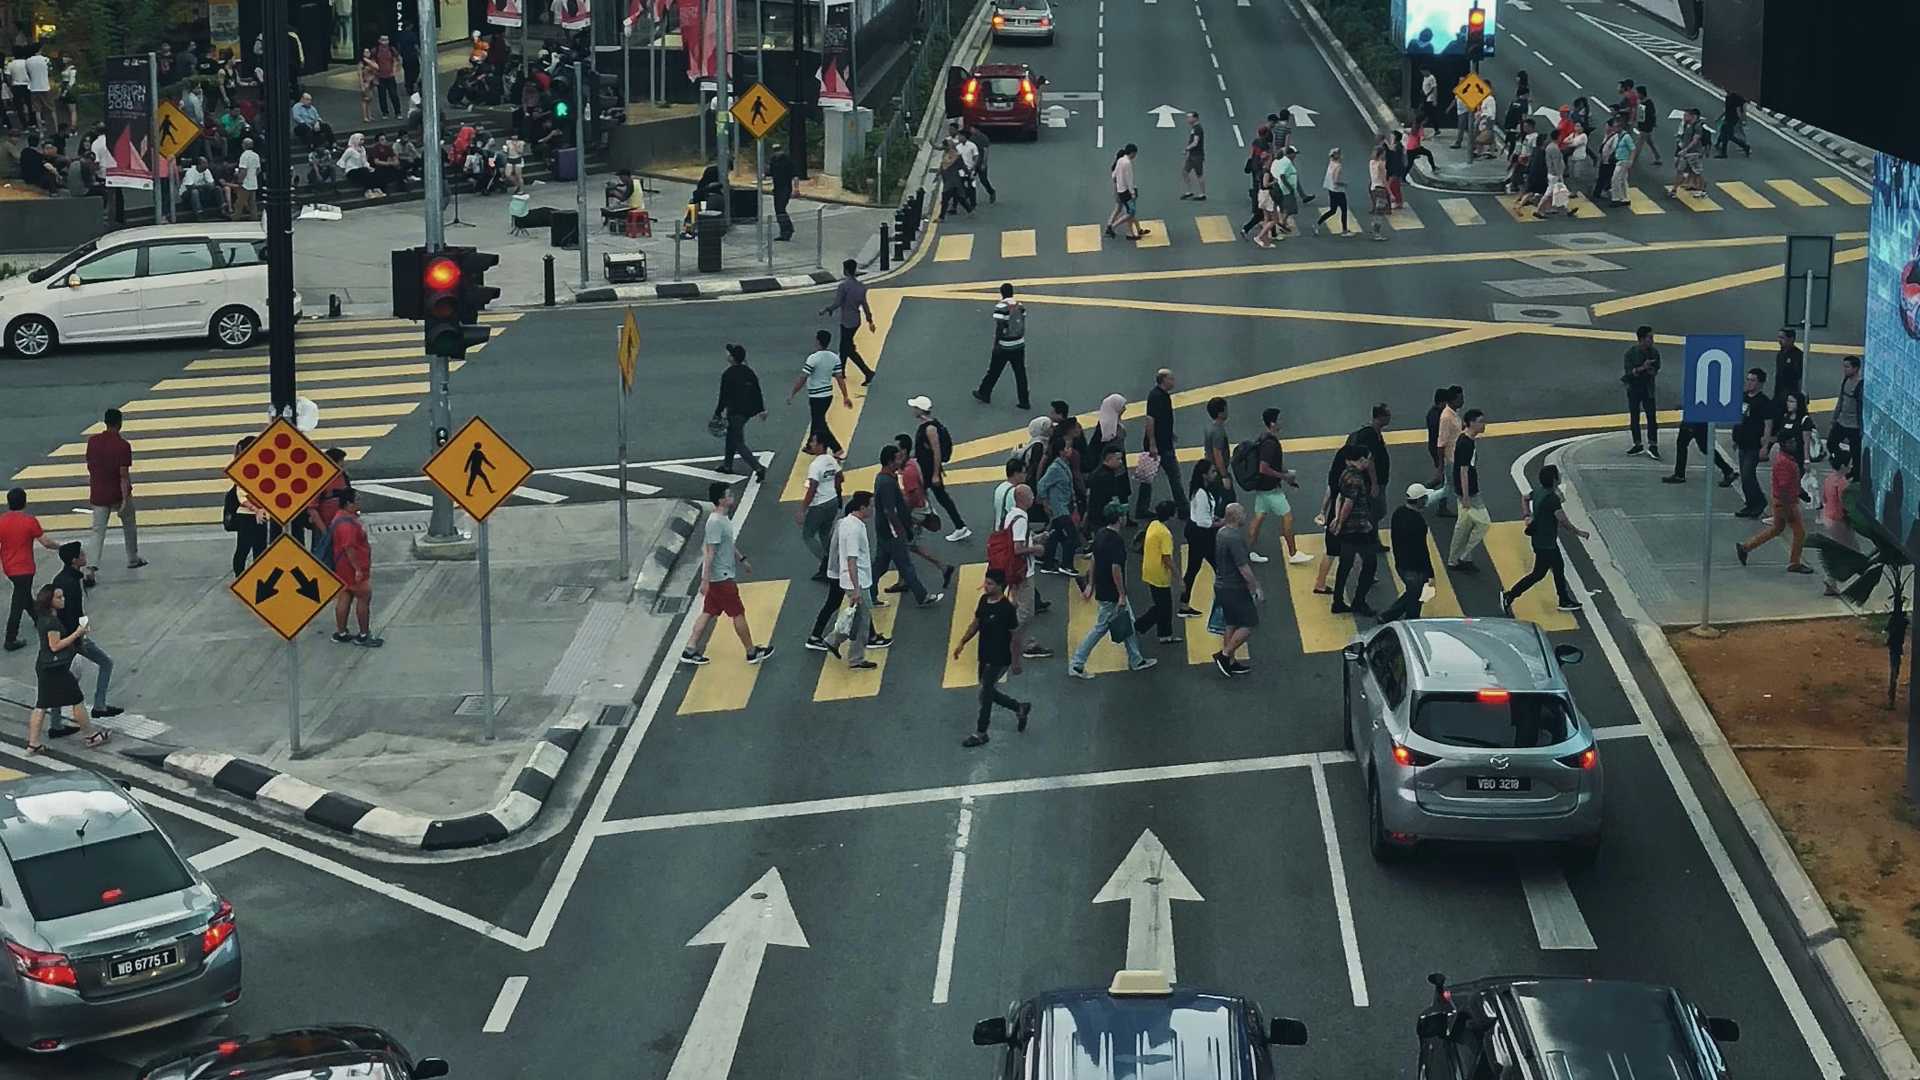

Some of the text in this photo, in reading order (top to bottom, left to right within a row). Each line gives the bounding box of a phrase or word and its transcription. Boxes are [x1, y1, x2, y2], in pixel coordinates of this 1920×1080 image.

[108, 84, 146, 95] DESIGN
[108, 93, 145, 103] MONTH
[108, 100, 134, 110] 2018
[118, 952, 169, 975] WB 6775 T
